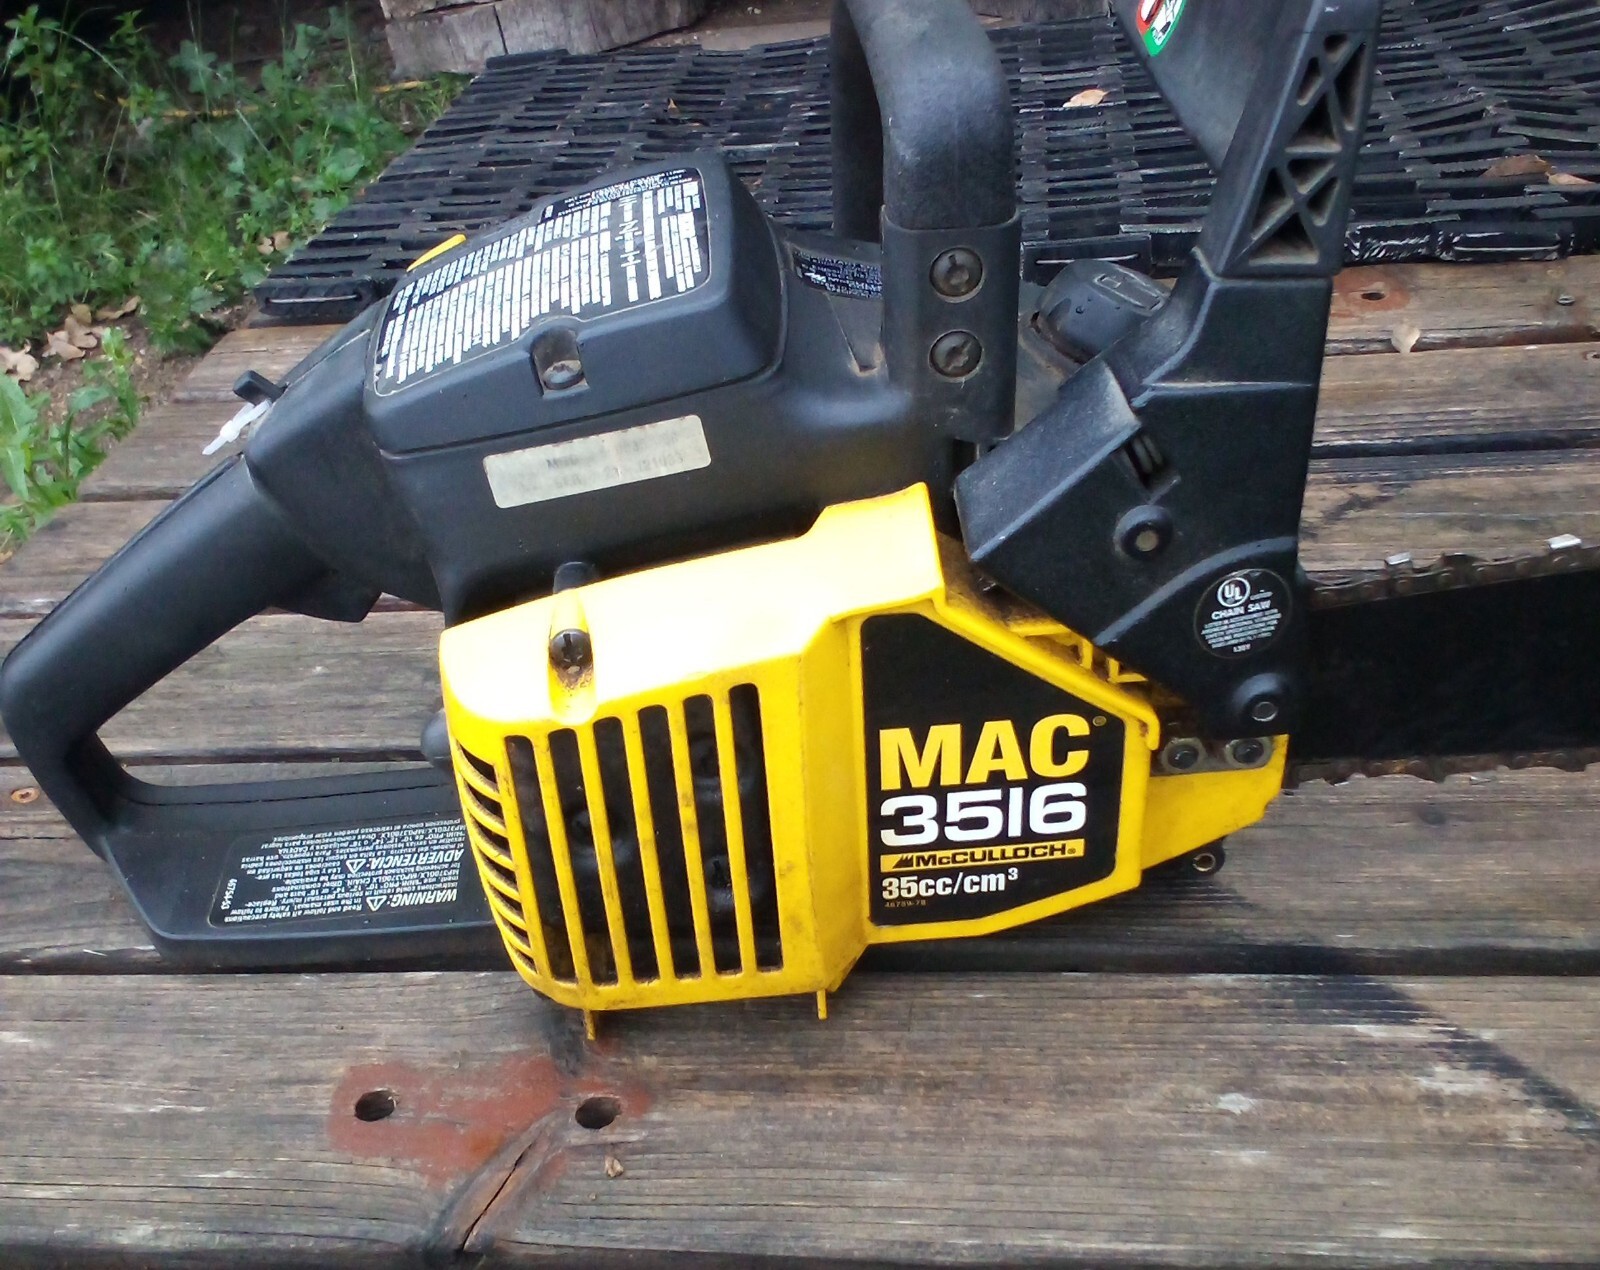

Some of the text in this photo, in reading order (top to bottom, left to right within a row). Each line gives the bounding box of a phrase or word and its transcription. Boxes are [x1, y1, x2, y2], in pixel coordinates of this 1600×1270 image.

[1211, 600, 1271, 620] CHAIN SAW
[879, 713, 1090, 791] MAC
[880, 782, 1087, 847] 3516
[366, 849, 464, 870] ADVERTENCIA:
[387, 889, 457, 907] WARNING:
